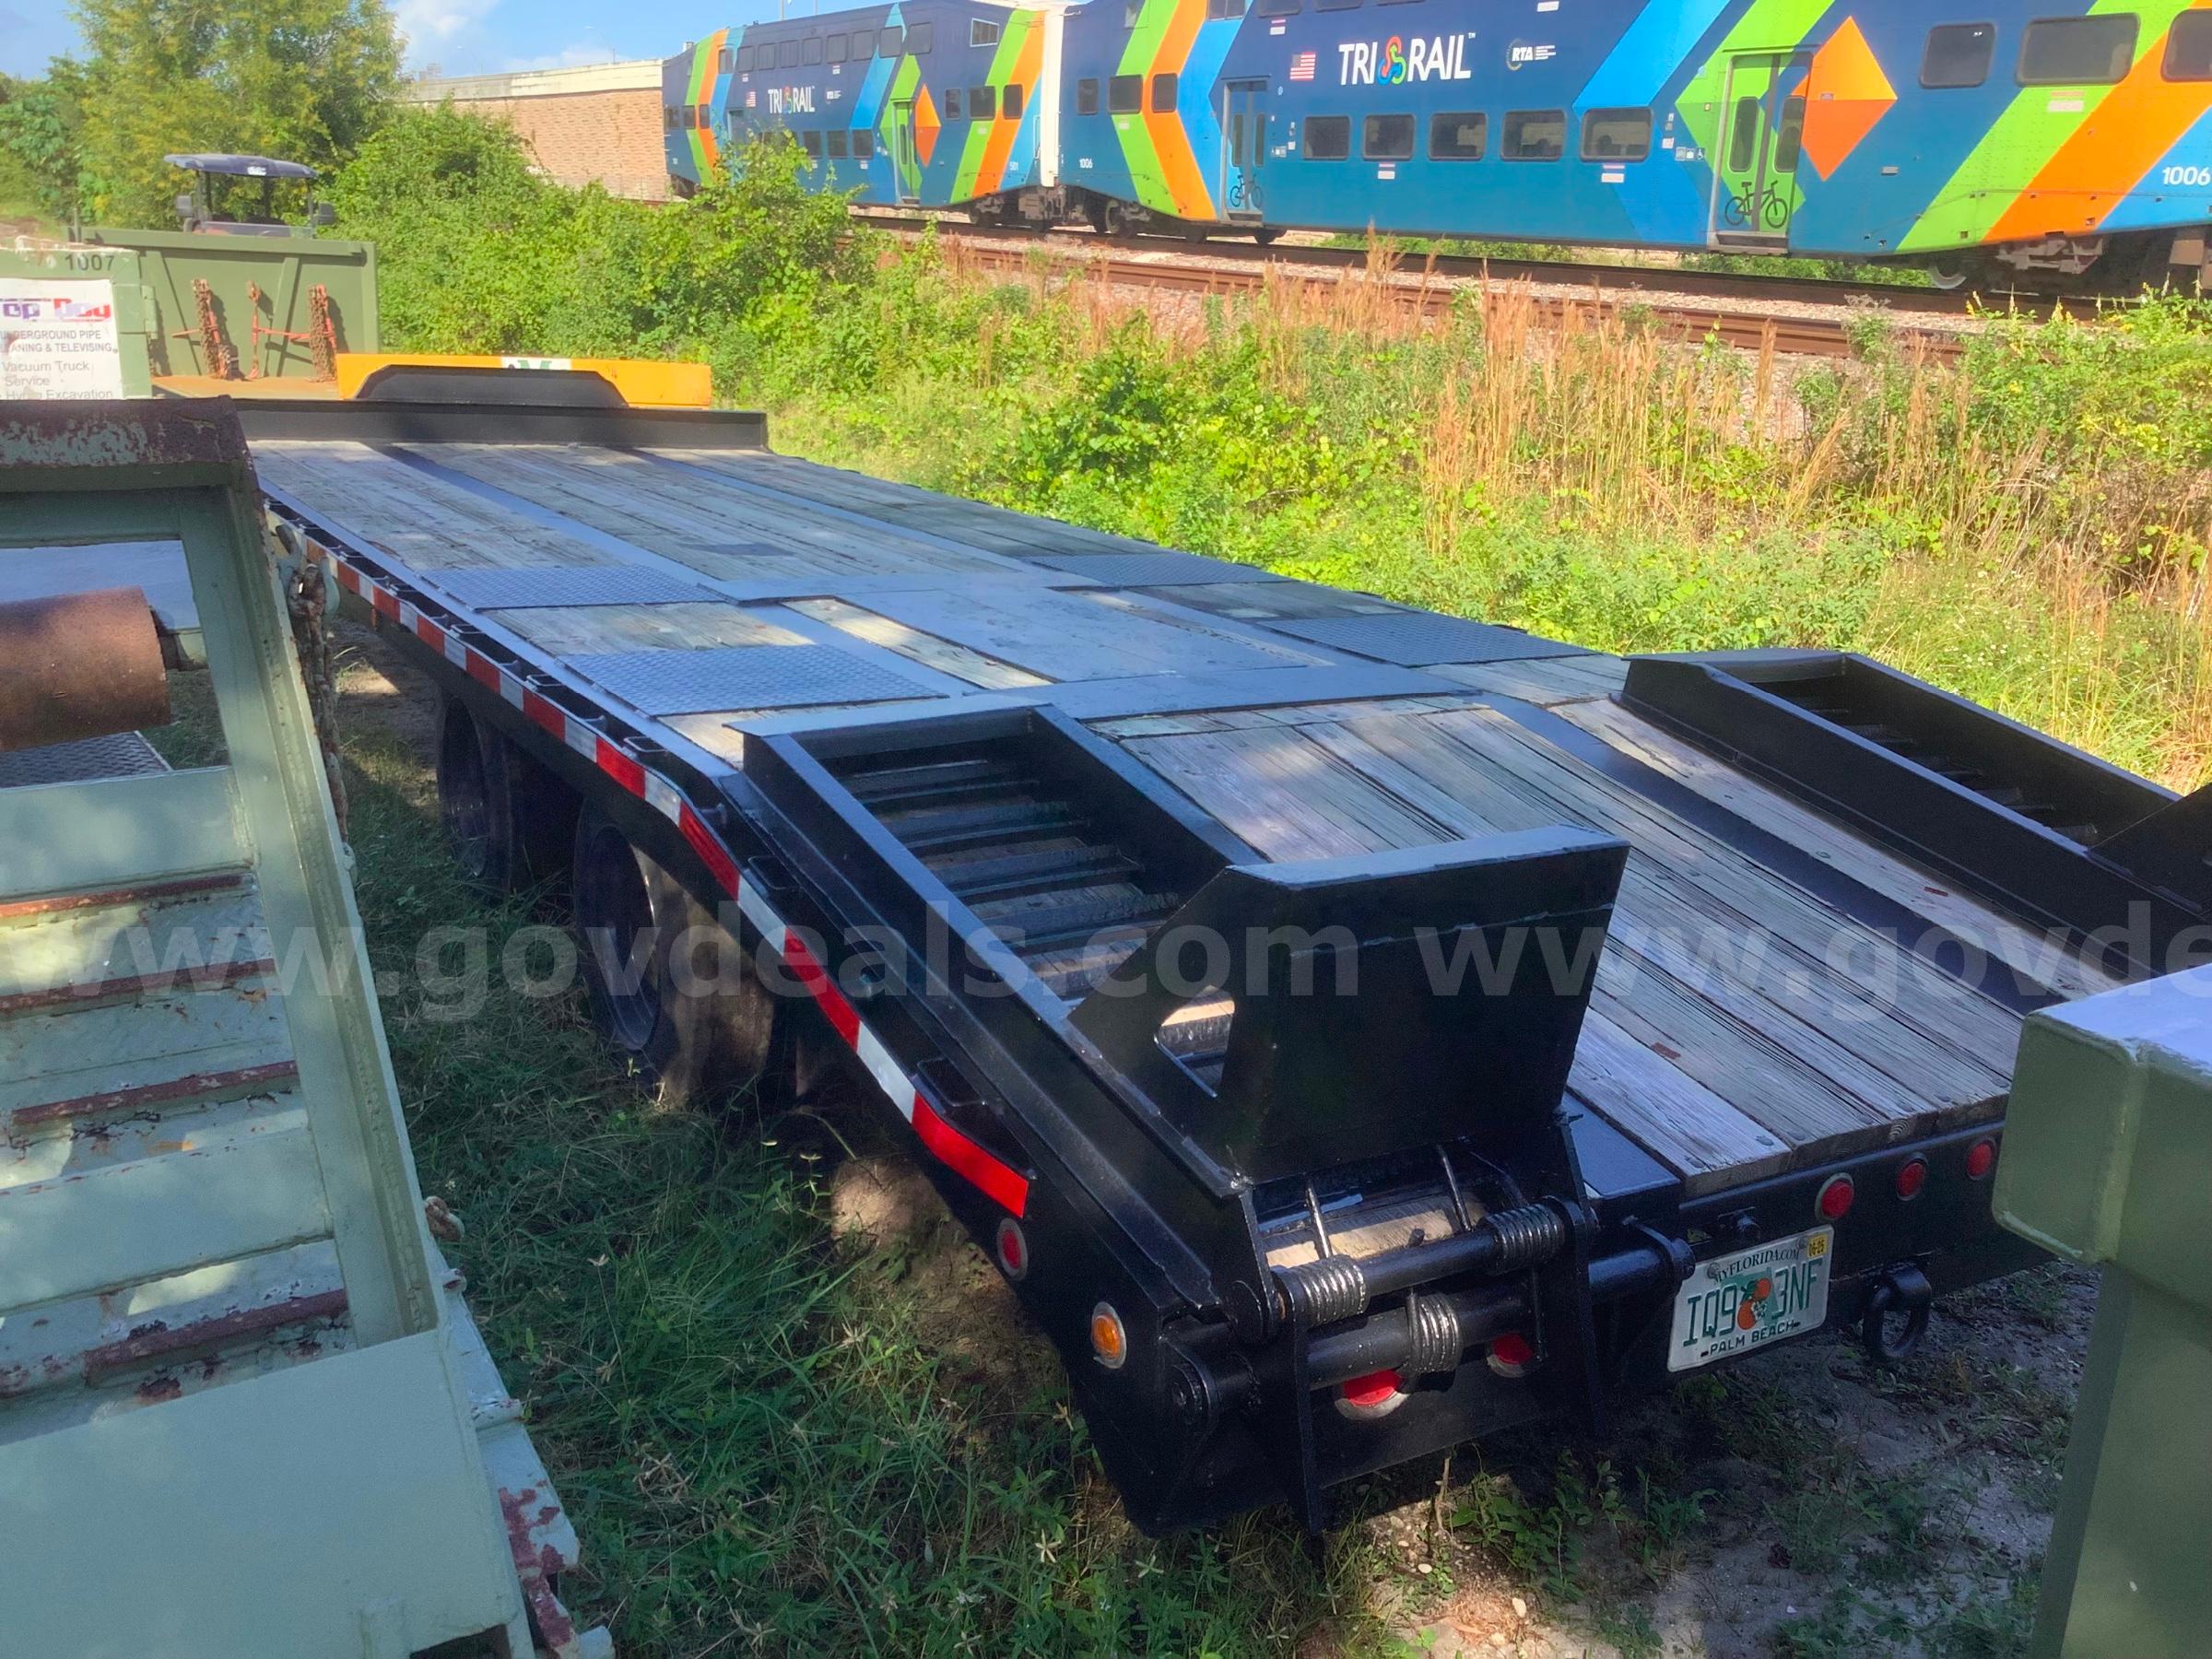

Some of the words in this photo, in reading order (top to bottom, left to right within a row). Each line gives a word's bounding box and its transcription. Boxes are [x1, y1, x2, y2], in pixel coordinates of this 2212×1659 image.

[1338, 41, 1378, 86] TRI
[1406, 34, 1472, 82] RAIL
[1512, 46, 1534, 62] RTA
[767, 88, 782, 114] TRI
[792, 87, 816, 112] RAIL
[2162, 166, 2211, 186] 1006
[65, 253, 115, 271] 1007
[79, 330, 101, 340] PIPE
[45, 343, 53, 353] &
[2, 360, 52, 372] Vacuum
[54, 360, 90, 371] Truck
[5, 374, 51, 387] Service
[46, 389, 113, 400] Excavation
[1683, 1285, 1737, 1347] IQ9
[1771, 1259, 1824, 1319] 3NF
[1710, 1336, 1745, 1355] PALM
[1751, 1320, 1794, 1343] BEACH
